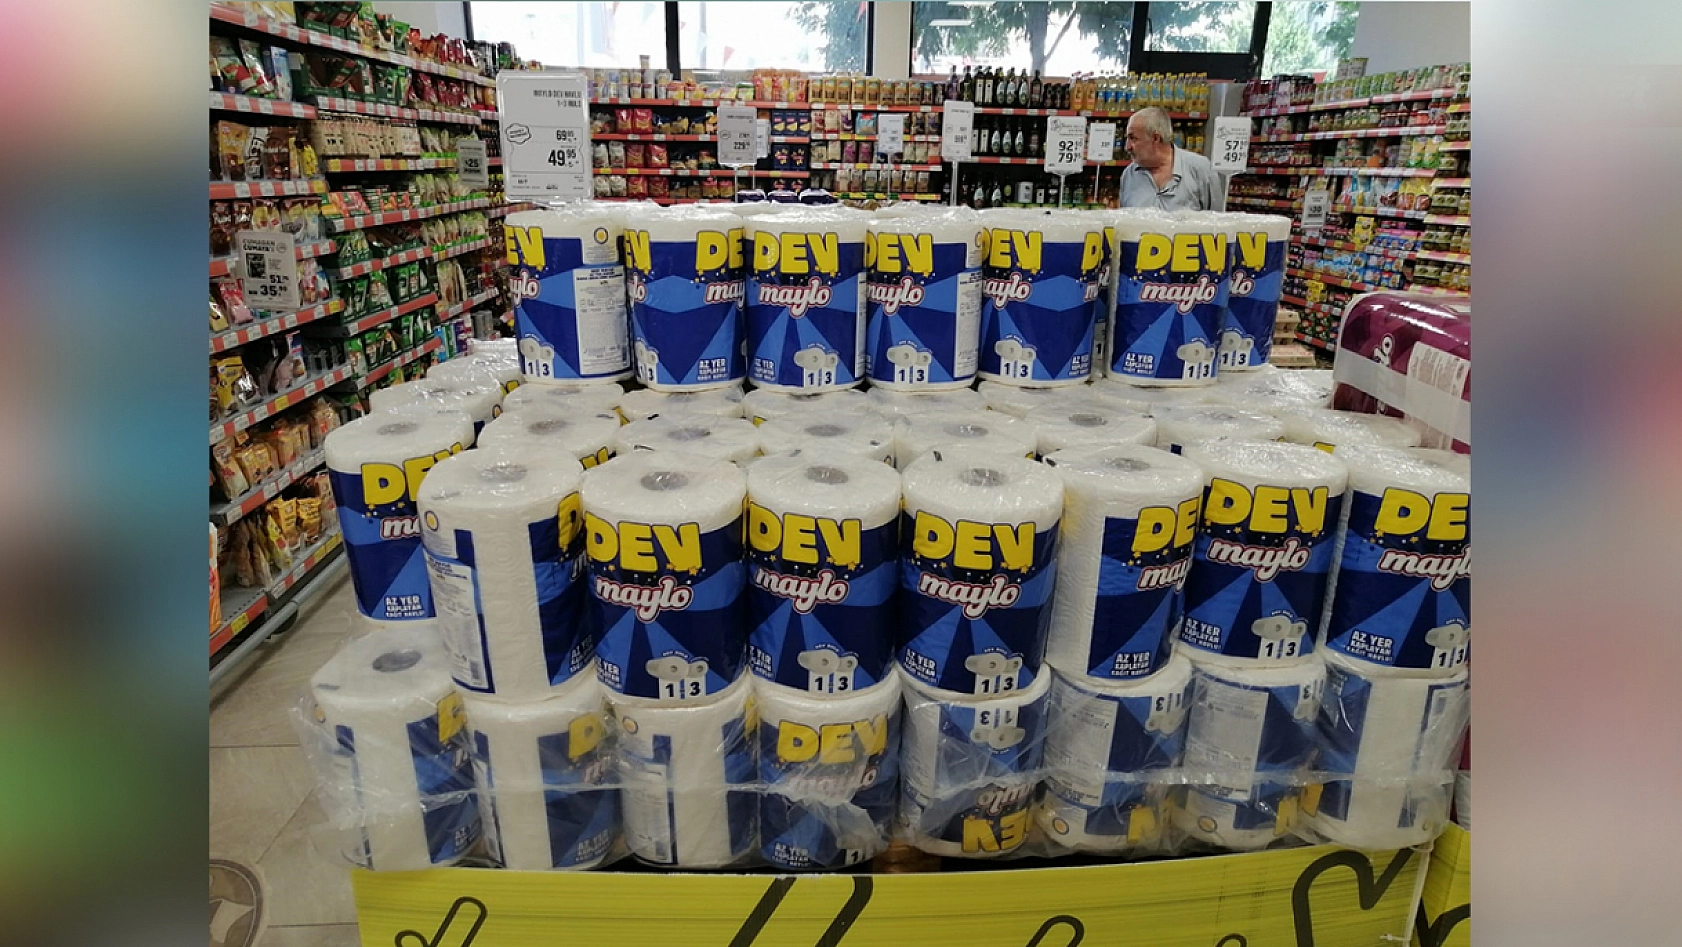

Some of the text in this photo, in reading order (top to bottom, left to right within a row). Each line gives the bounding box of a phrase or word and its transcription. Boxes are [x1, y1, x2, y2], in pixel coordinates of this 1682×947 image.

[753, 231, 838, 274] DEV
[1136, 233, 1227, 273] DEV
[758, 277, 831, 318] maylo
[1139, 275, 1218, 314] maylo
[528, 362, 549, 376] 1 3
[898, 369, 926, 382] 1 3
[1003, 362, 1029, 377] 1 3
[1188, 364, 1210, 378] 1 3
[1222, 352, 1246, 365] 1 3
[807, 372, 832, 385] 1 3
[1204, 478, 1329, 534] DEV
[1374, 487, 1470, 541] DE
[585, 511, 703, 573] DEV
[749, 501, 862, 568] DEV
[913, 510, 1036, 571] DEV
[1206, 537, 1312, 582] maylo
[1377, 545, 1471, 591] mayl
[595, 576, 694, 624] maylo
[755, 569, 850, 615] maylo
[918, 572, 1022, 620] maylo
[1265, 641, 1296, 657] 1 3
[1352, 630, 1393, 648] AZ YER
[1439, 649, 1465, 667] 1 3
[665, 681, 701, 698] 1 3
[814, 676, 849, 691] 1 3
[981, 677, 1014, 693] 1 3
[980, 710, 991, 726] 3
[776, 713, 888, 764] DEV
